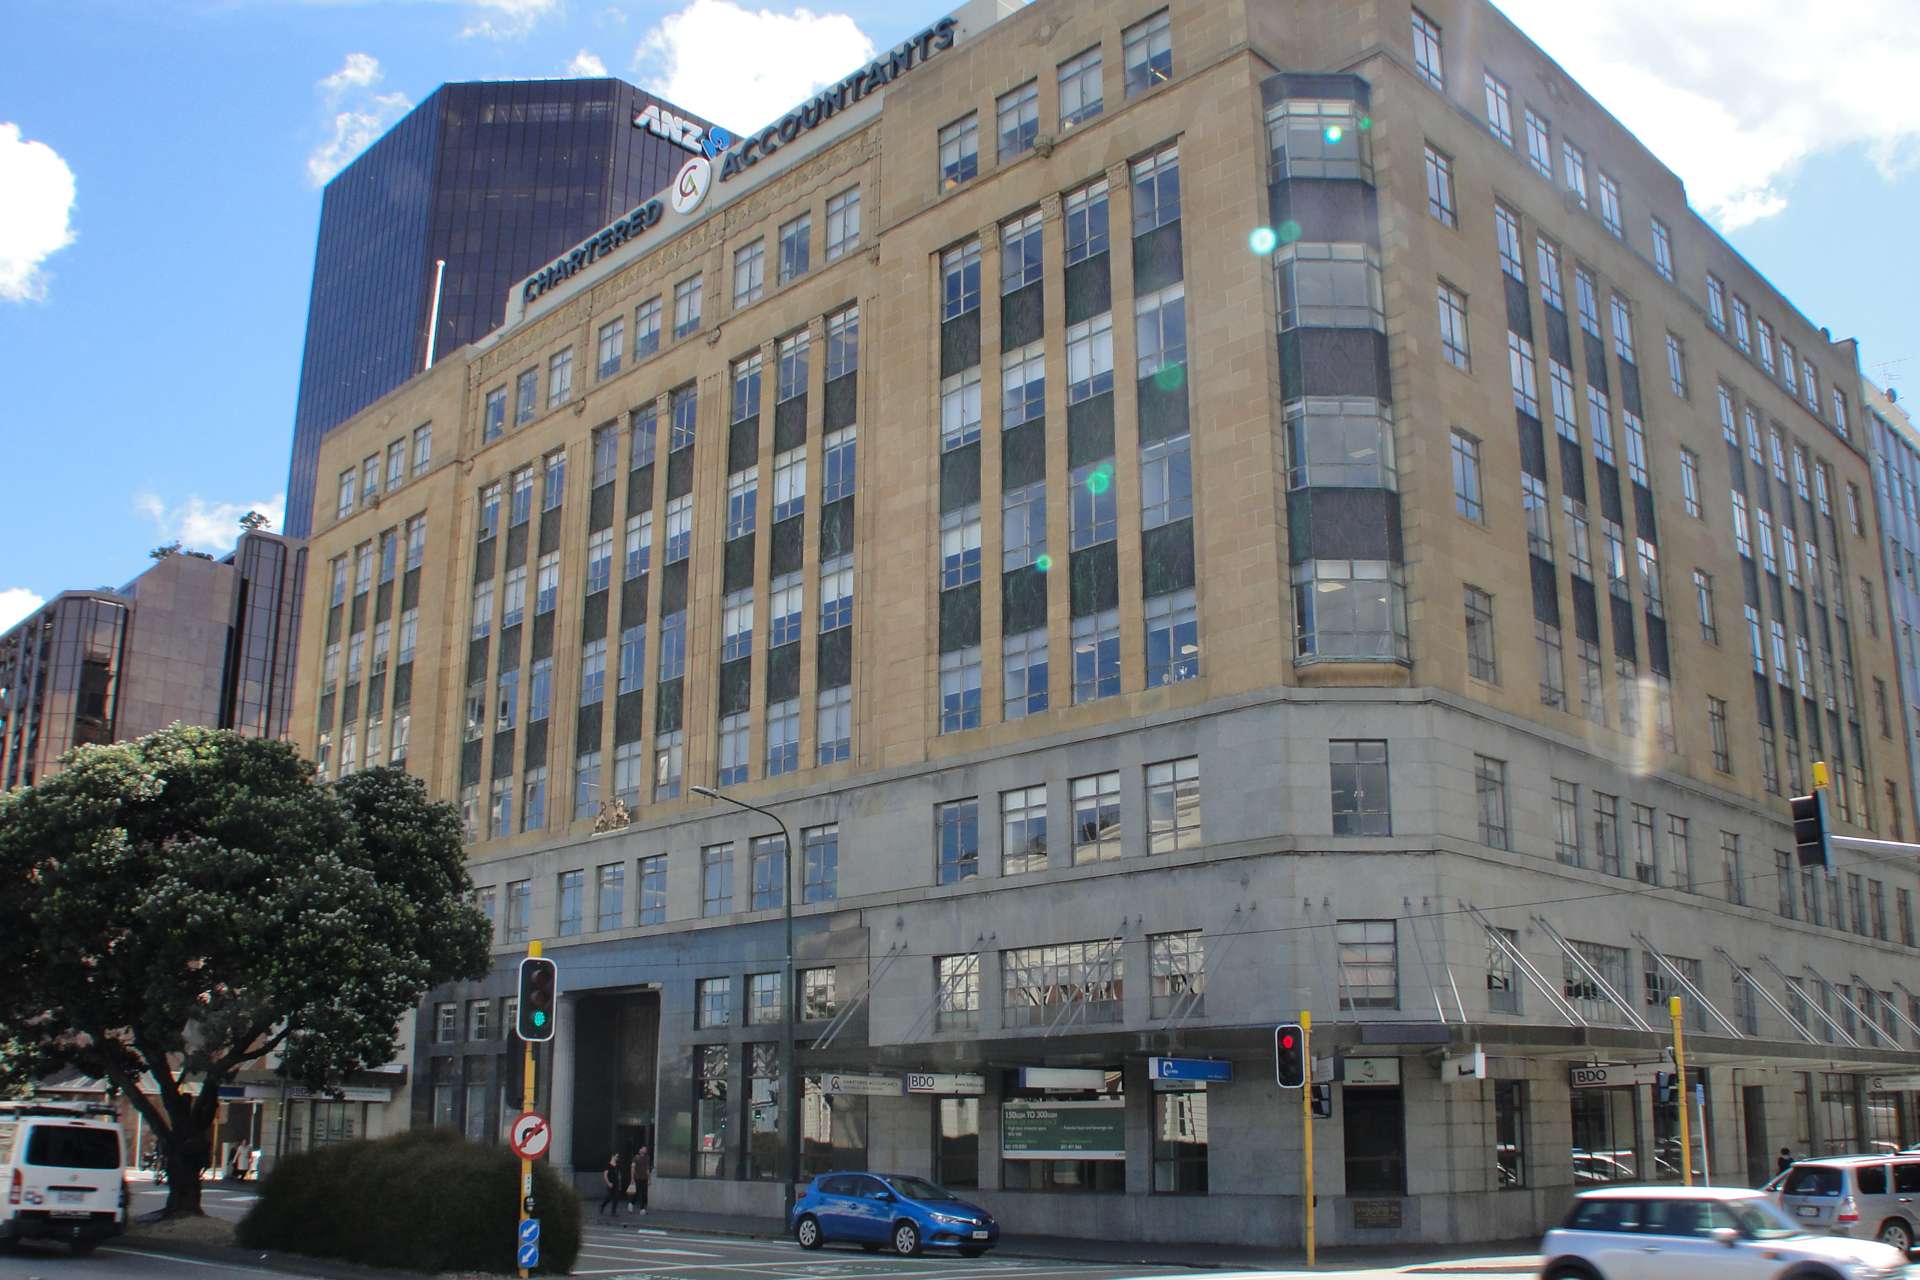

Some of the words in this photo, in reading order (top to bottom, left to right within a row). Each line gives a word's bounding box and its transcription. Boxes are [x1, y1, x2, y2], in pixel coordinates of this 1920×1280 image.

[633, 105, 703, 154] ANZ
[522, 199, 663, 304] CHARTERED
[719, 17, 958, 183] ACCOUNTANTS
[911, 1075, 935, 1088] BDO
[1577, 1069, 1607, 1083] BDO
